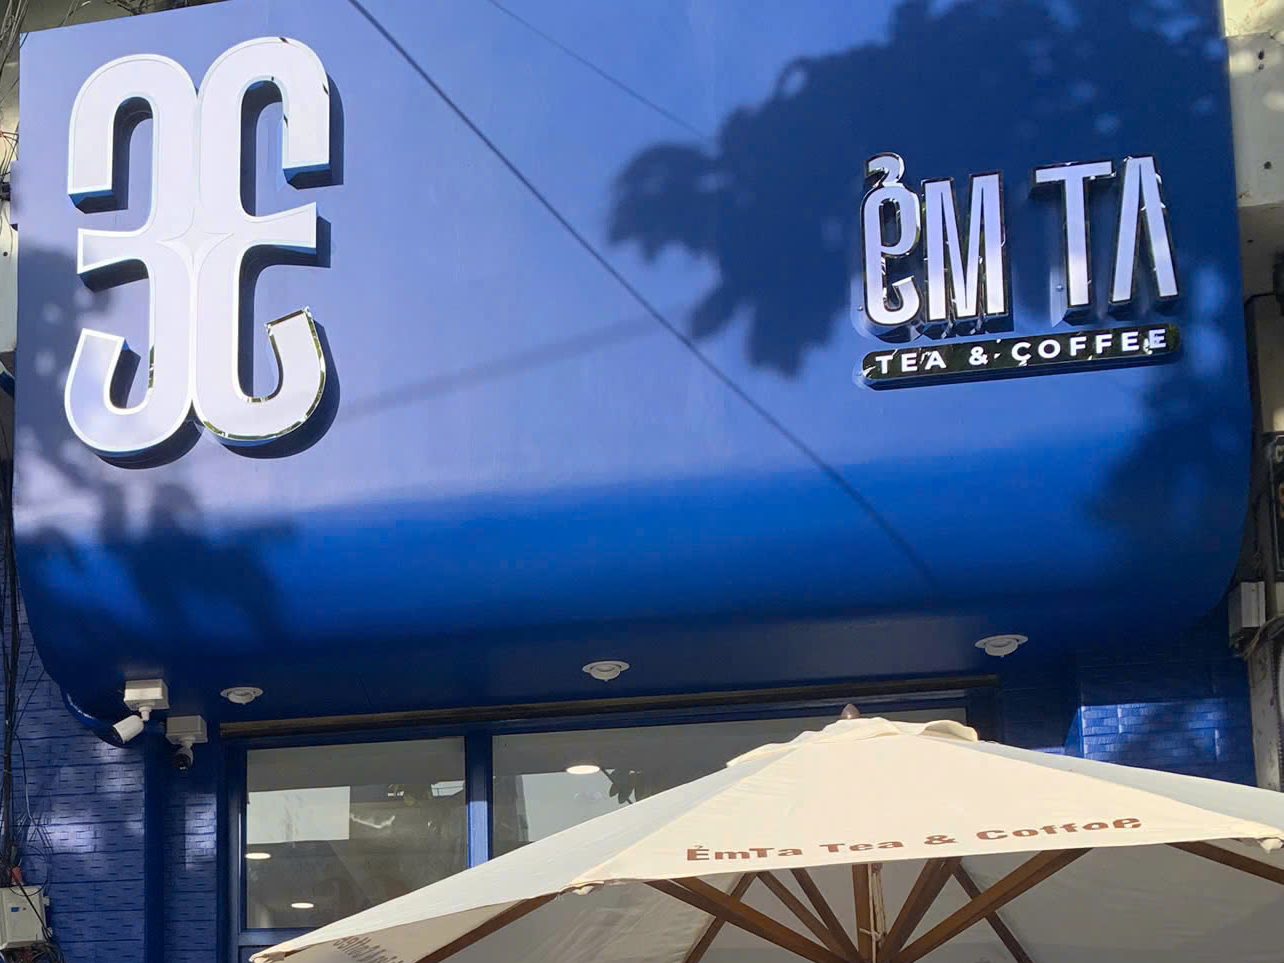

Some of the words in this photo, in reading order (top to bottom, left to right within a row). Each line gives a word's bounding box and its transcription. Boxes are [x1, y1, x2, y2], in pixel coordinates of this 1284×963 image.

[875, 352, 948, 374] TEA
[968, 346, 989, 366] &
[1011, 328, 1168, 362] COFFEE
[820, 840, 905, 853] Tea
[923, 834, 957, 845] &
[976, 818, 1142, 840] Coffee
